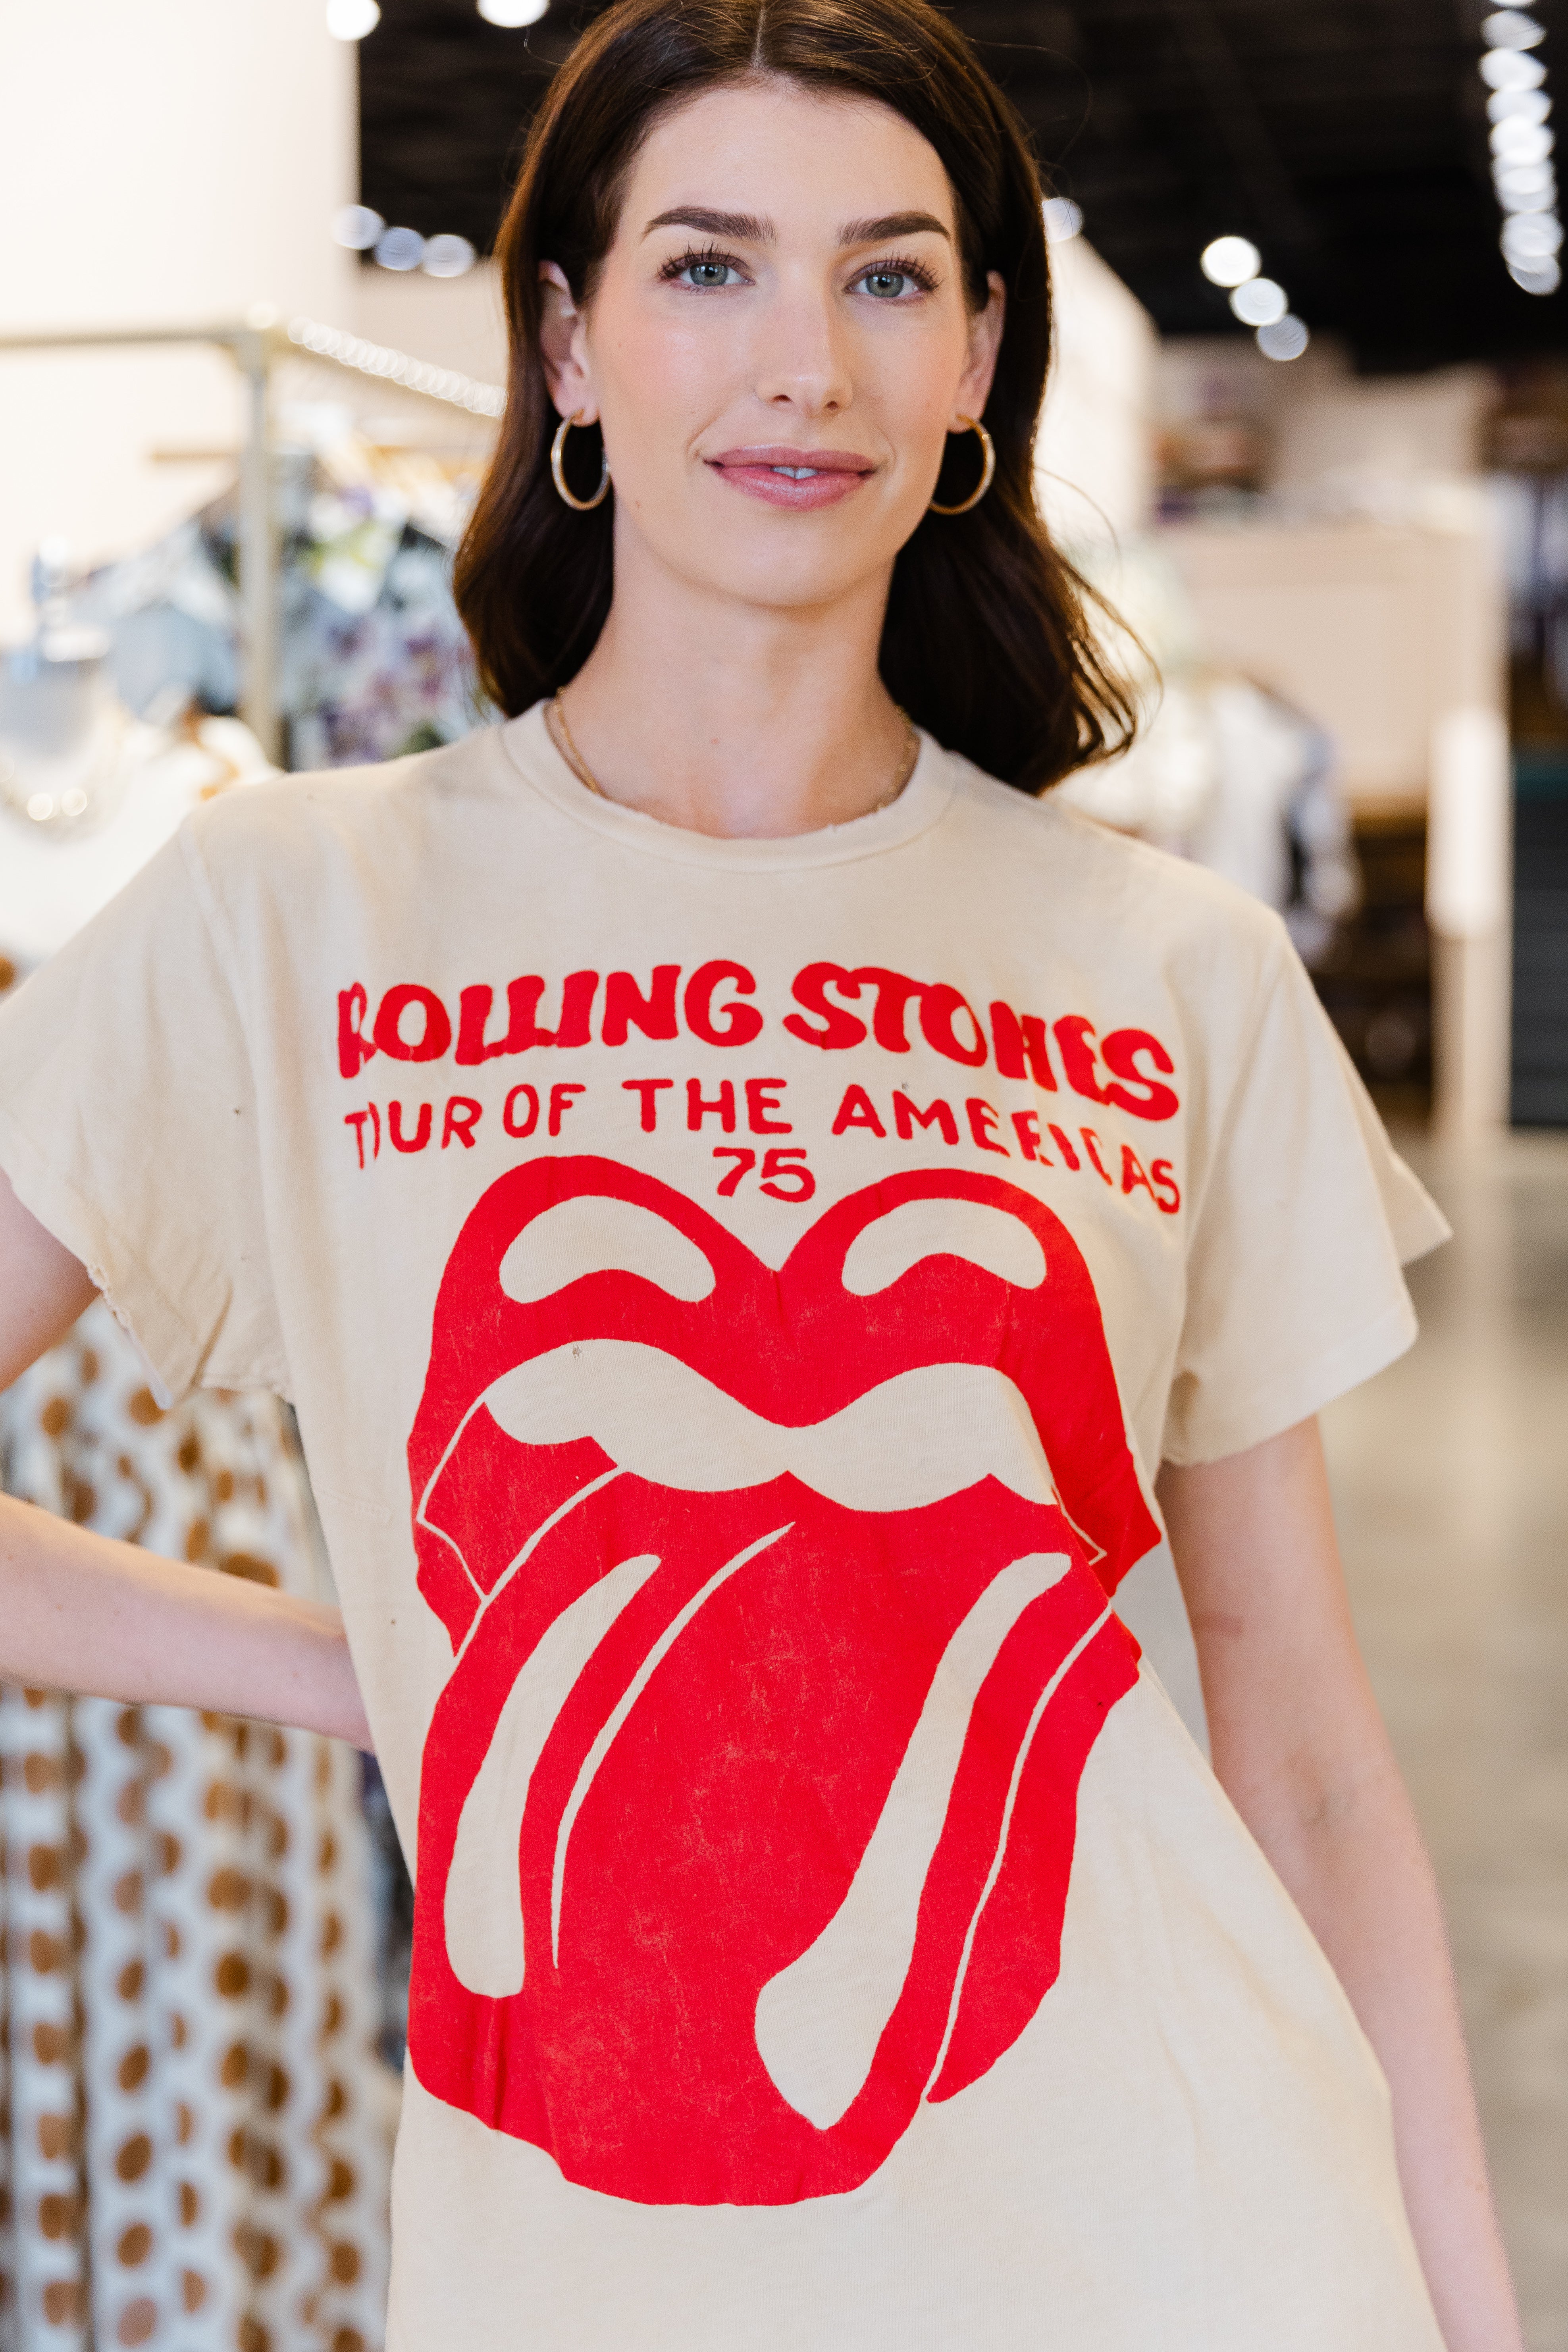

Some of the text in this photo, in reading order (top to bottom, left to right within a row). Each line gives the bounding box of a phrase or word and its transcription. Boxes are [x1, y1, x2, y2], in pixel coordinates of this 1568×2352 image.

[337, 959, 1180, 1123] ROLLING STONES
[502, 1082, 587, 1139] OF
[620, 1077, 794, 1135] THE
[712, 1146, 817, 1204] 75
